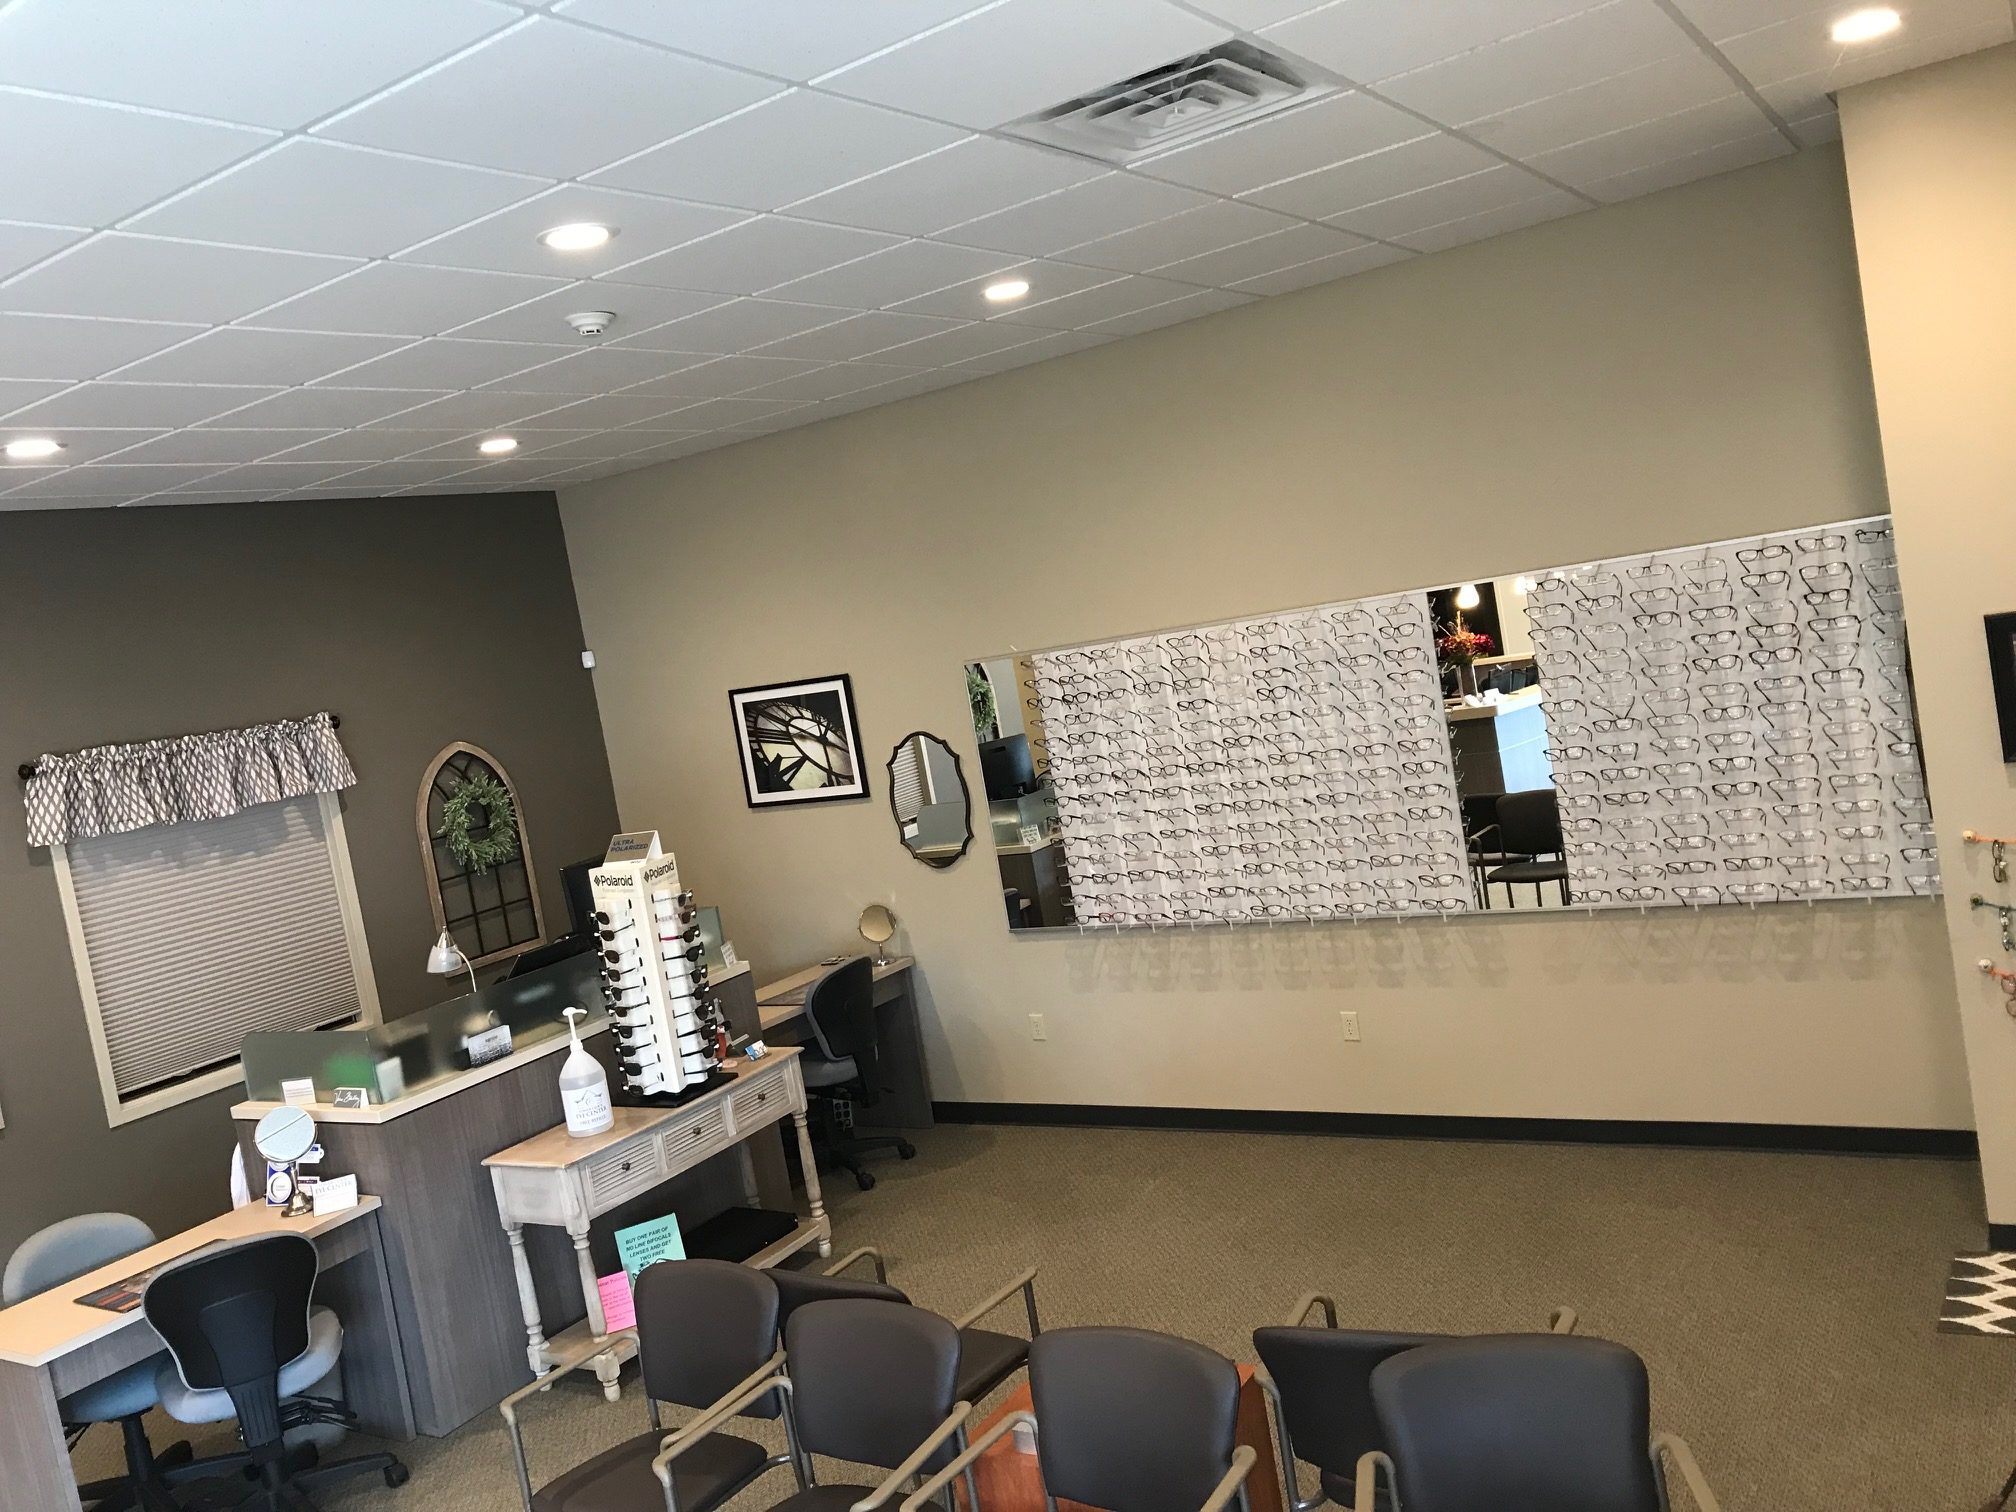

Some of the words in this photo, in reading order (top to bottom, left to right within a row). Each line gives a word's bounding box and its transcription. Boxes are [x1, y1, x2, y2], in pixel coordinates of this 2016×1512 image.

[611, 843, 648, 852] POLARIZED
[649, 860, 675, 880] Polaroid
[600, 875, 633, 886] Polaroid
[648, 1229, 660, 1237] PAIR
[635, 1241, 646, 1249] LINE
[646, 1232, 671, 1245] BIFOCALS
[630, 1248, 649, 1258] LENSES
[650, 1243, 661, 1251] AND
[652, 1249, 665, 1257] FREE
